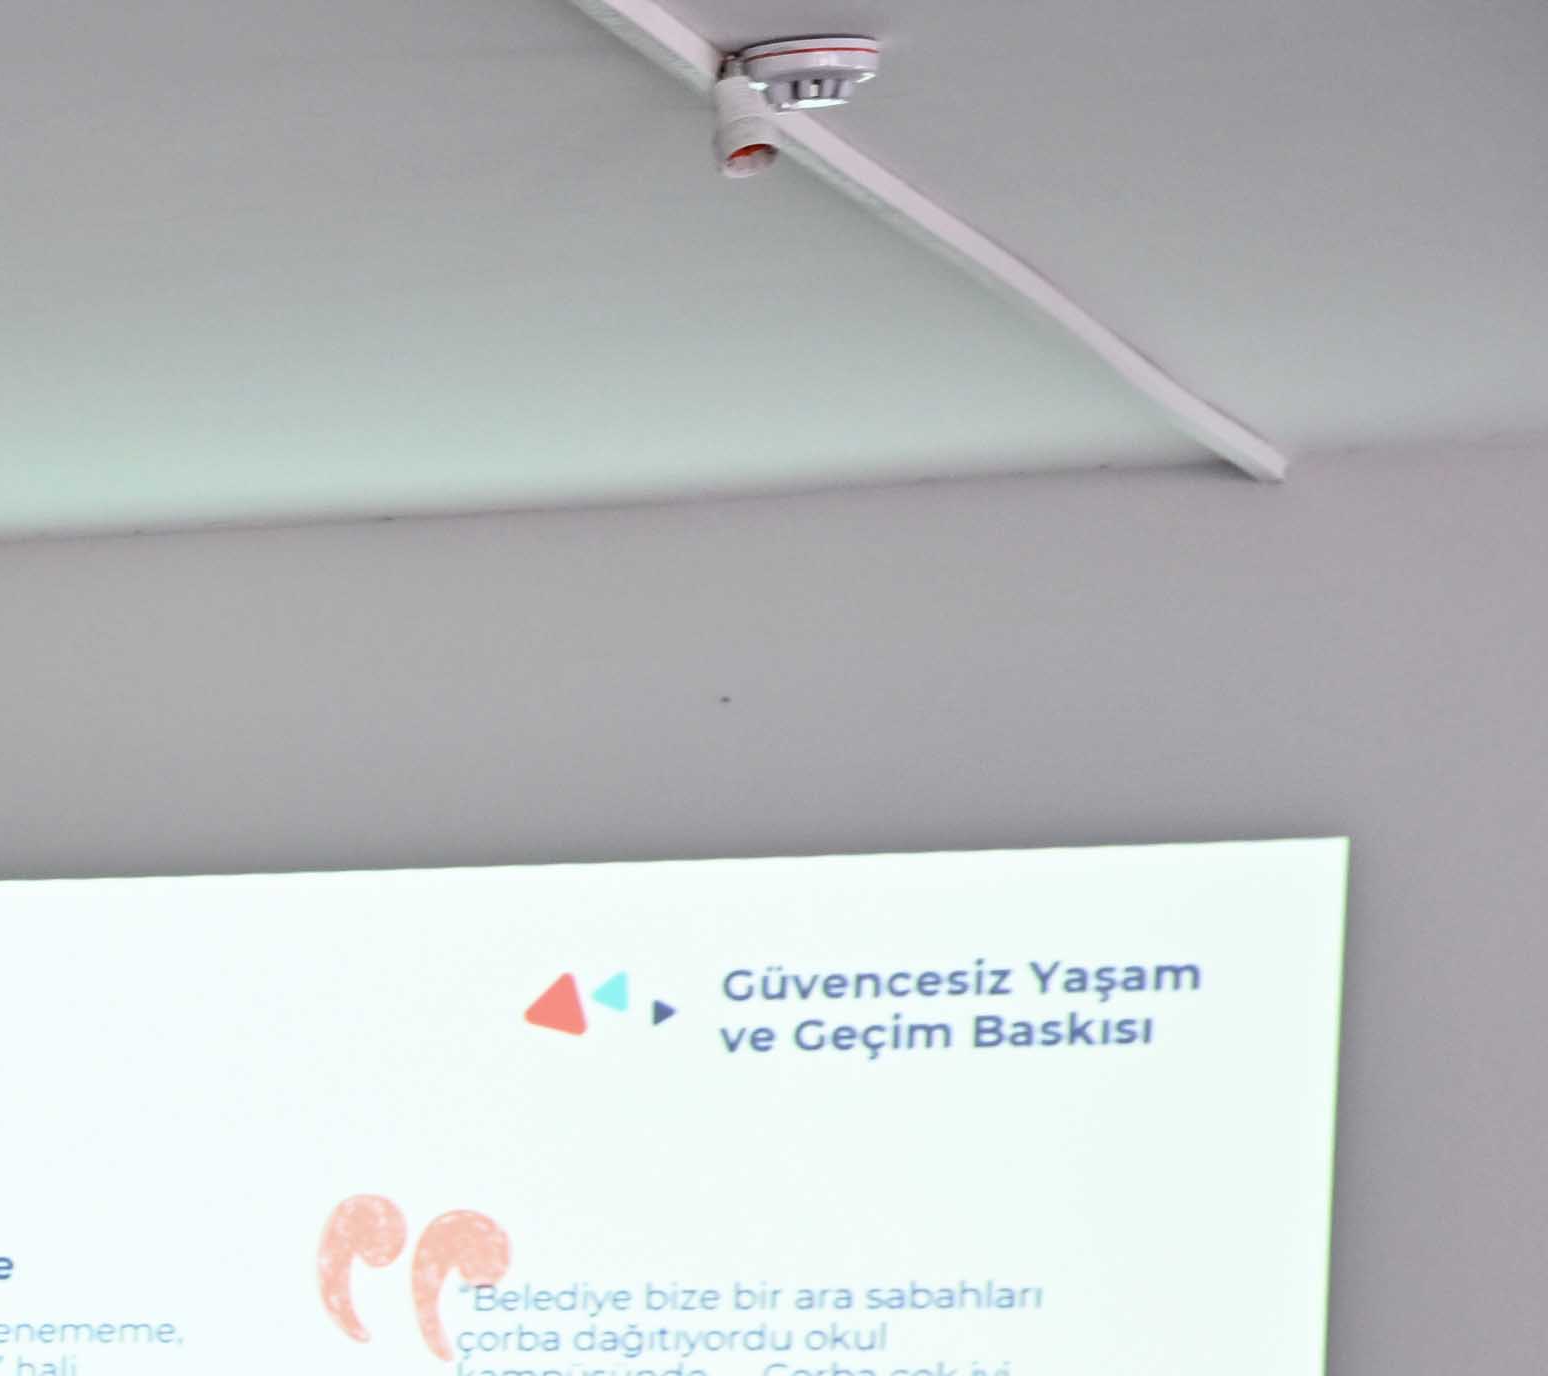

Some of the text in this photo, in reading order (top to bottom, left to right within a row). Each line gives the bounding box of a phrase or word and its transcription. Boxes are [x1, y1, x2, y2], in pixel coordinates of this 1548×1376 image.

[722, 956, 1202, 1002] Güvencesiz Yaşam
[720, 1012, 1154, 1060] ve Geçim Baskısı
[646, 1283, 721, 1312] bize
[734, 1281, 781, 1310] bir
[795, 1287, 853, 1310] ara
[865, 1280, 1043, 1310] sabahları
[456, 1321, 888, 1360] çorba dağıtıyordu okul
